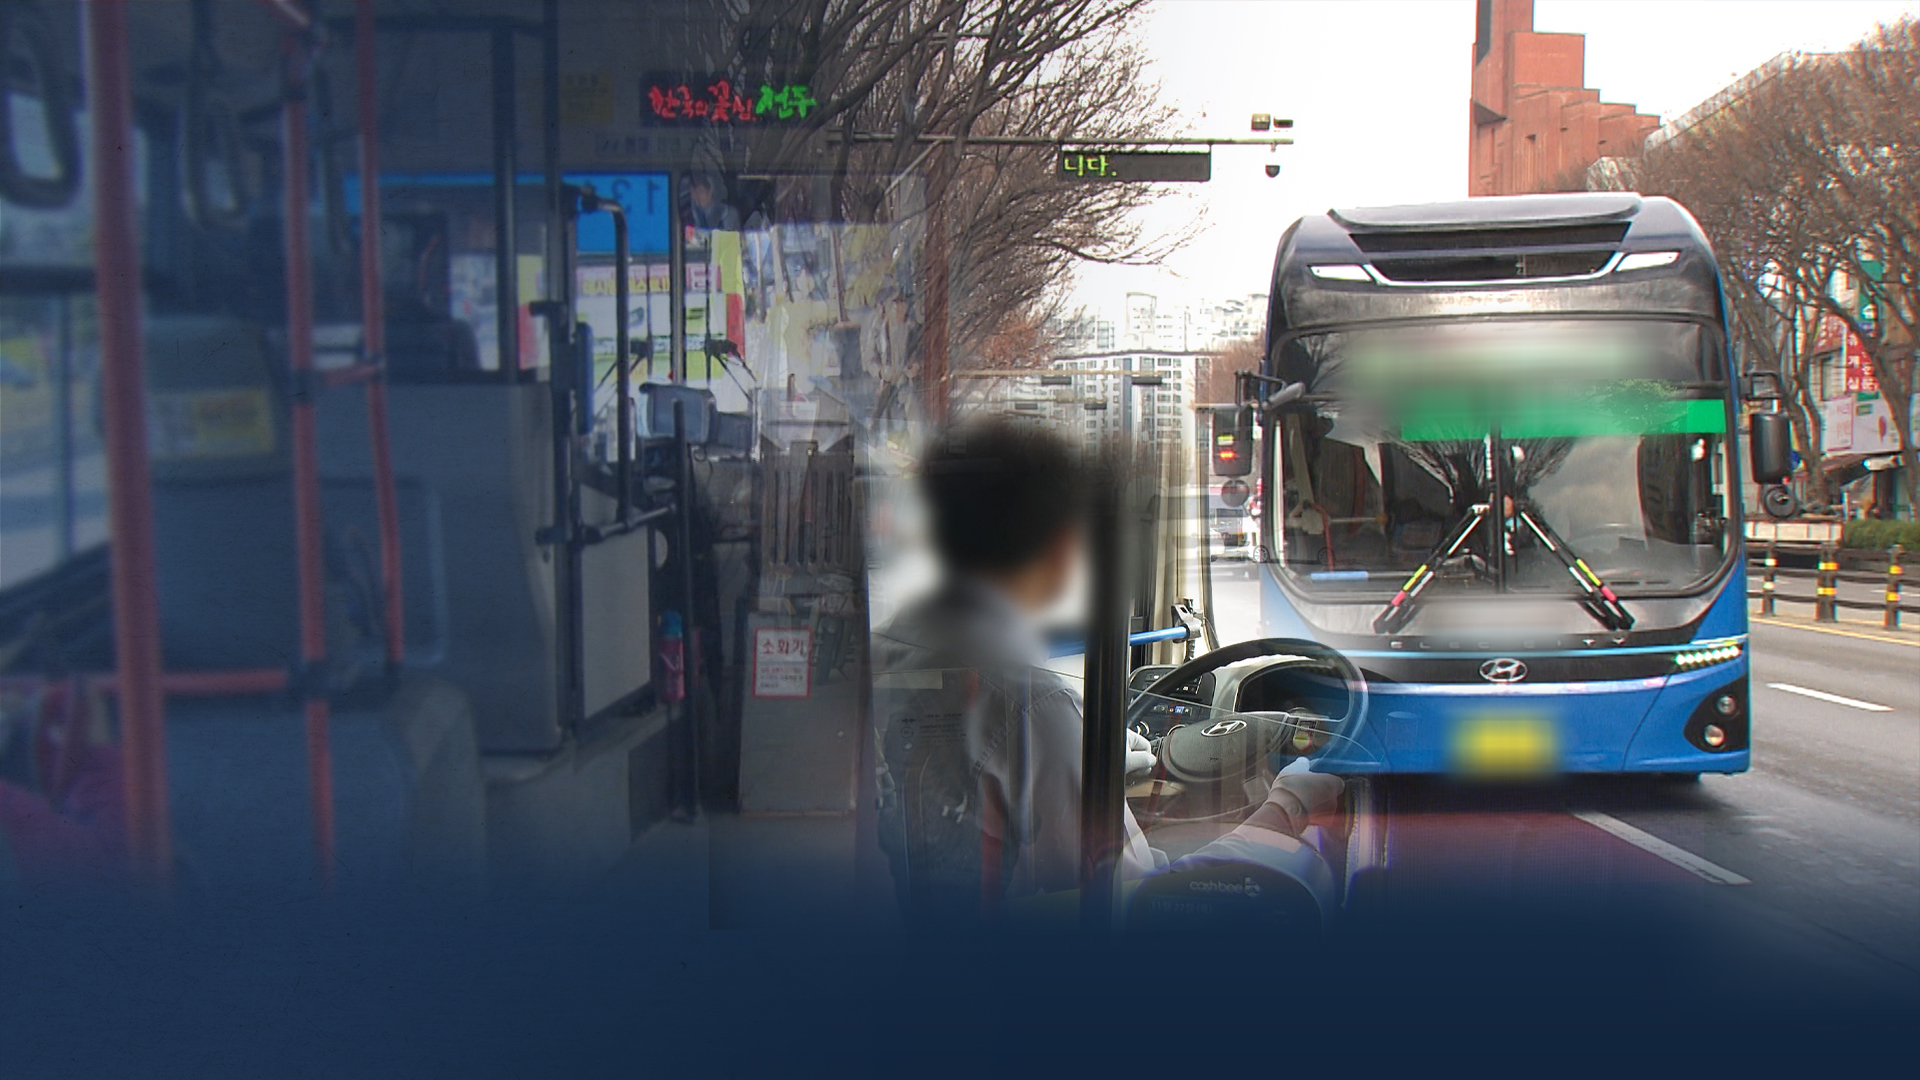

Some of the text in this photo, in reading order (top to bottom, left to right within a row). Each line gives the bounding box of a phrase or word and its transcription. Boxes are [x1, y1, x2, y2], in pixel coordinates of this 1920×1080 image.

[648, 84, 708, 119] 한국의
[755, 84, 818, 120] 전주
[1063, 154, 1118, 177] 니다.
[761, 637, 805, 657] 소화기
[1188, 879, 1243, 895] cashbee
